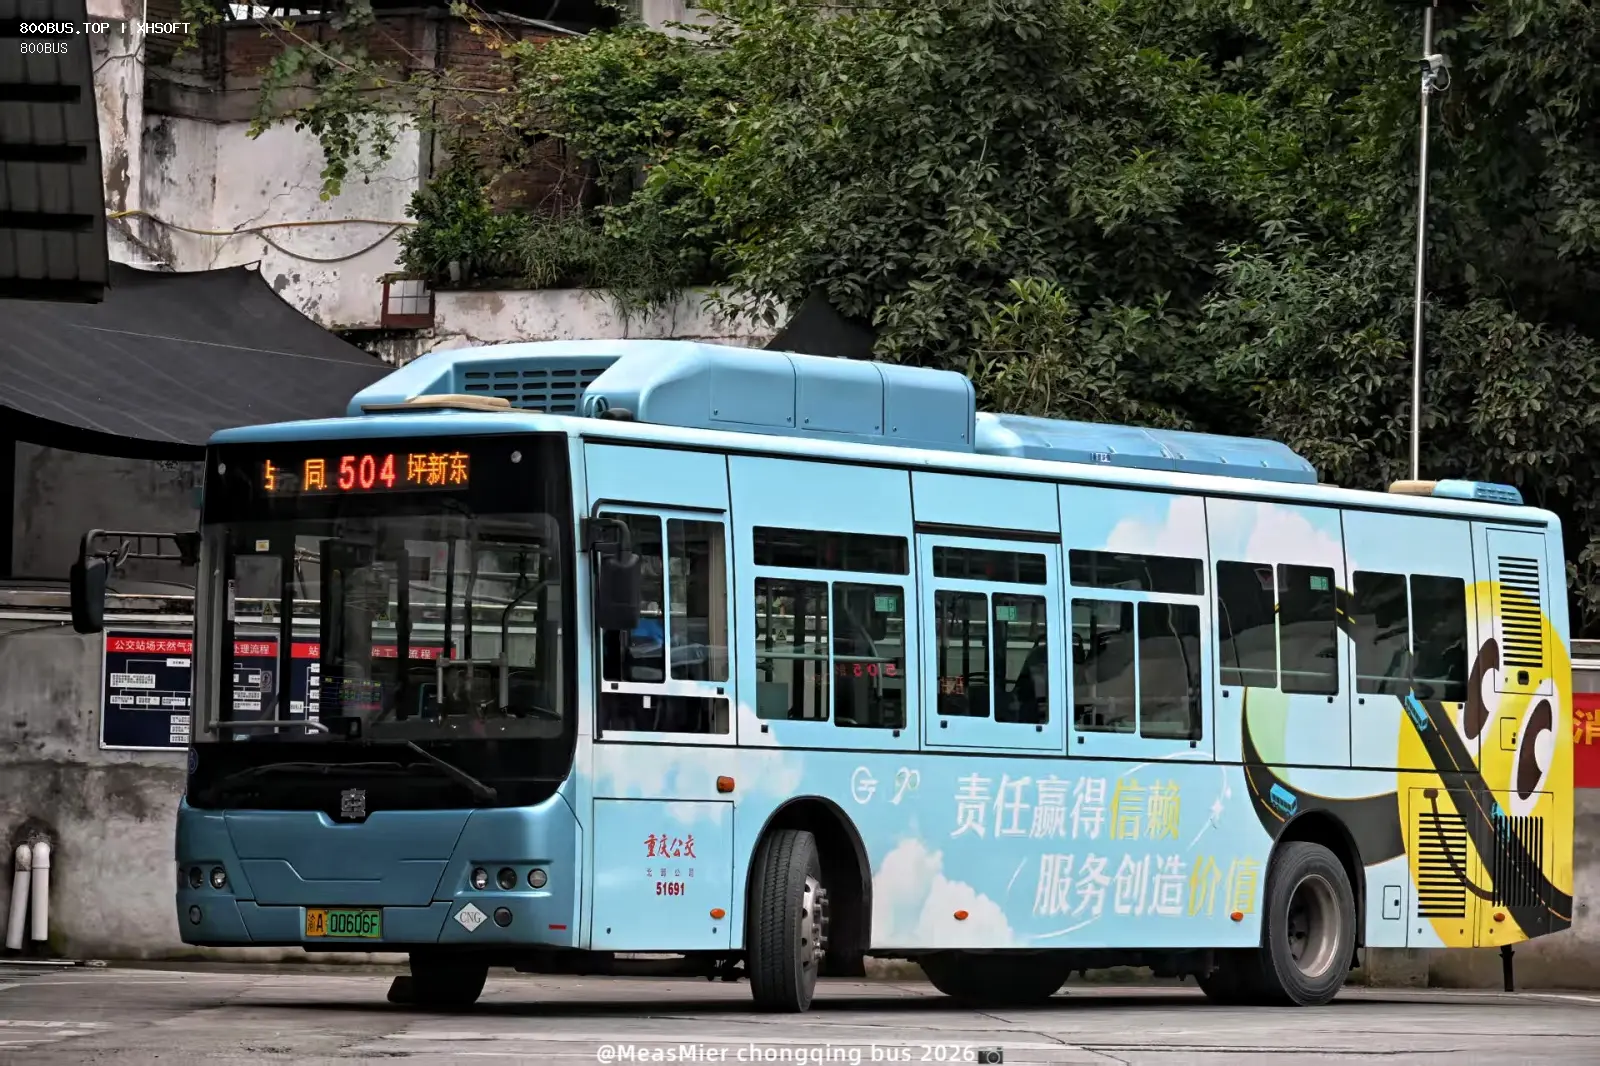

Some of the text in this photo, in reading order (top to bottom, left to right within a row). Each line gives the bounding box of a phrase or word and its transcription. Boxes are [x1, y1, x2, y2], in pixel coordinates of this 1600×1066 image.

[339, 454, 396, 490] 504
[407, 452, 469, 485] 坪新东
[951, 773, 1181, 840] 责任赢得信赖
[643, 834, 697, 859] 重庆公交
[656, 881, 685, 896] 51691
[1033, 853, 1260, 918] 服务创造价值
[459, 910, 482, 924] CNG
